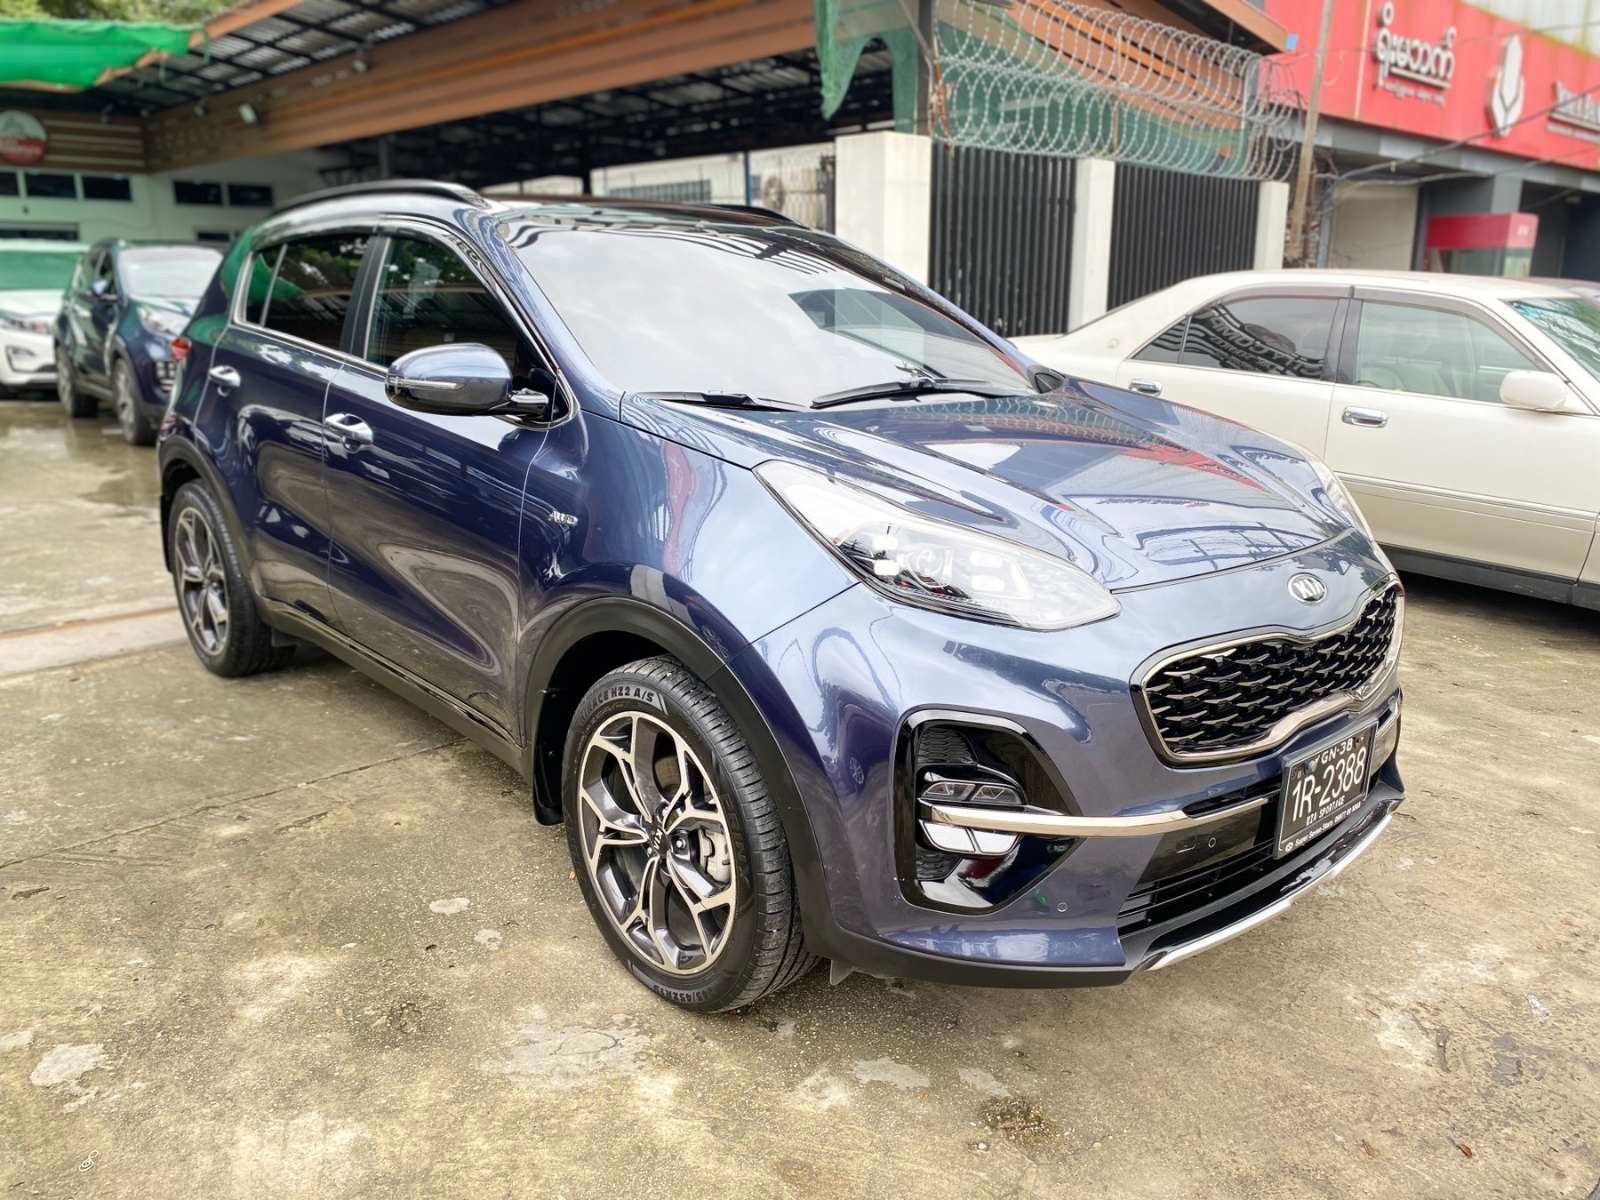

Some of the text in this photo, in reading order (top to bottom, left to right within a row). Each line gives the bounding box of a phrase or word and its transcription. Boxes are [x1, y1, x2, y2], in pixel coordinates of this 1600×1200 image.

[1292, 577, 1323, 600] KIA
[633, 687, 655, 703] A/S
[1292, 747, 1368, 822] 1R-2388
